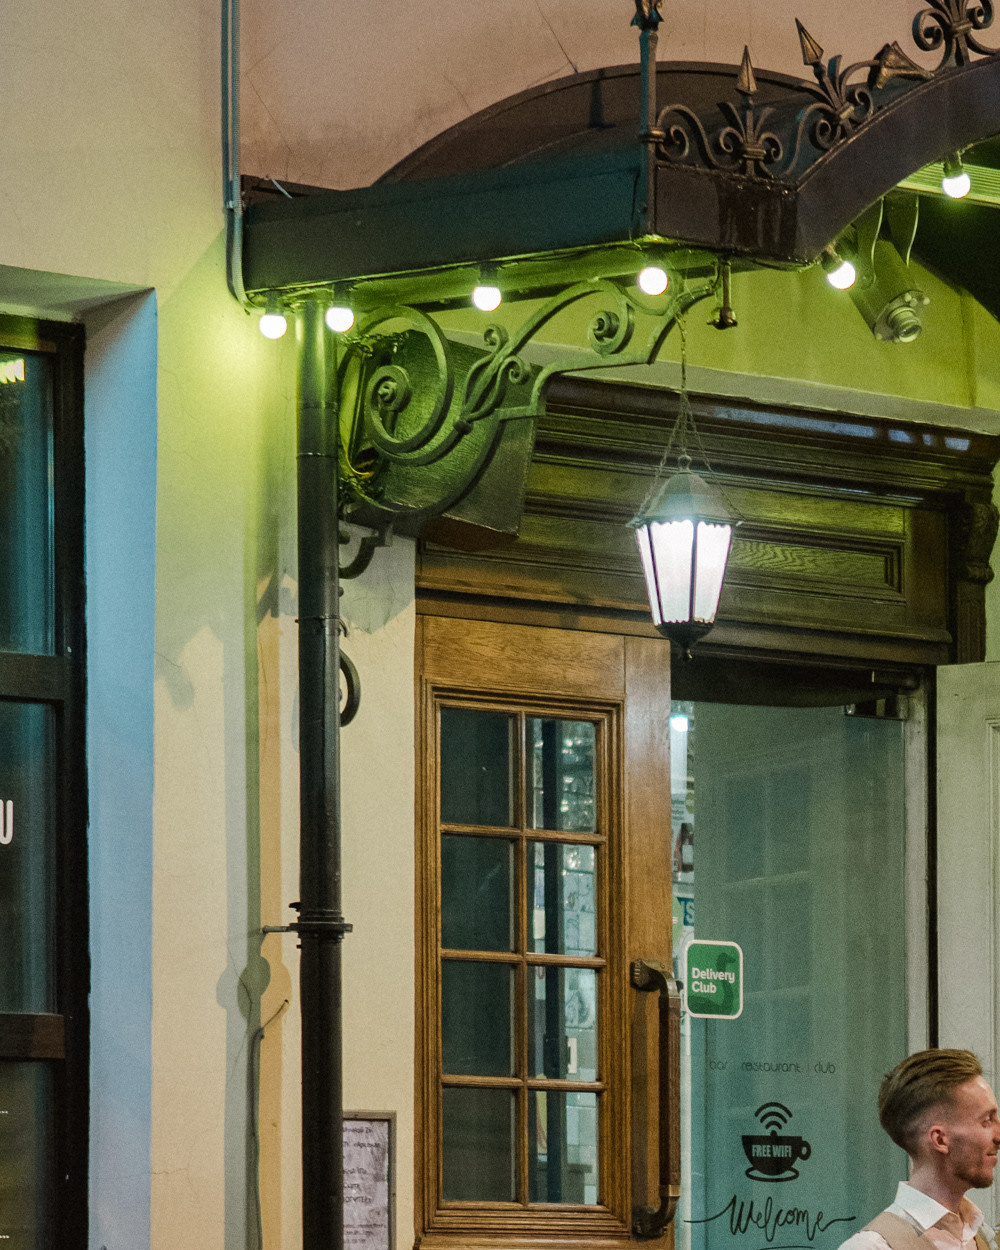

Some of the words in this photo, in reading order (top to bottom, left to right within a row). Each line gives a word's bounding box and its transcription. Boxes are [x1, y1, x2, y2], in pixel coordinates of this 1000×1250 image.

[691, 967, 736, 984] Delivery
[691, 980, 717, 994] Club
[741, 1060, 801, 1073] restaurant
[814, 1061, 836, 1074] club
[752, 1144, 772, 1158] FREE
[773, 1144, 793, 1158] WIFI
[684, 1194, 856, 1242] Welcome
